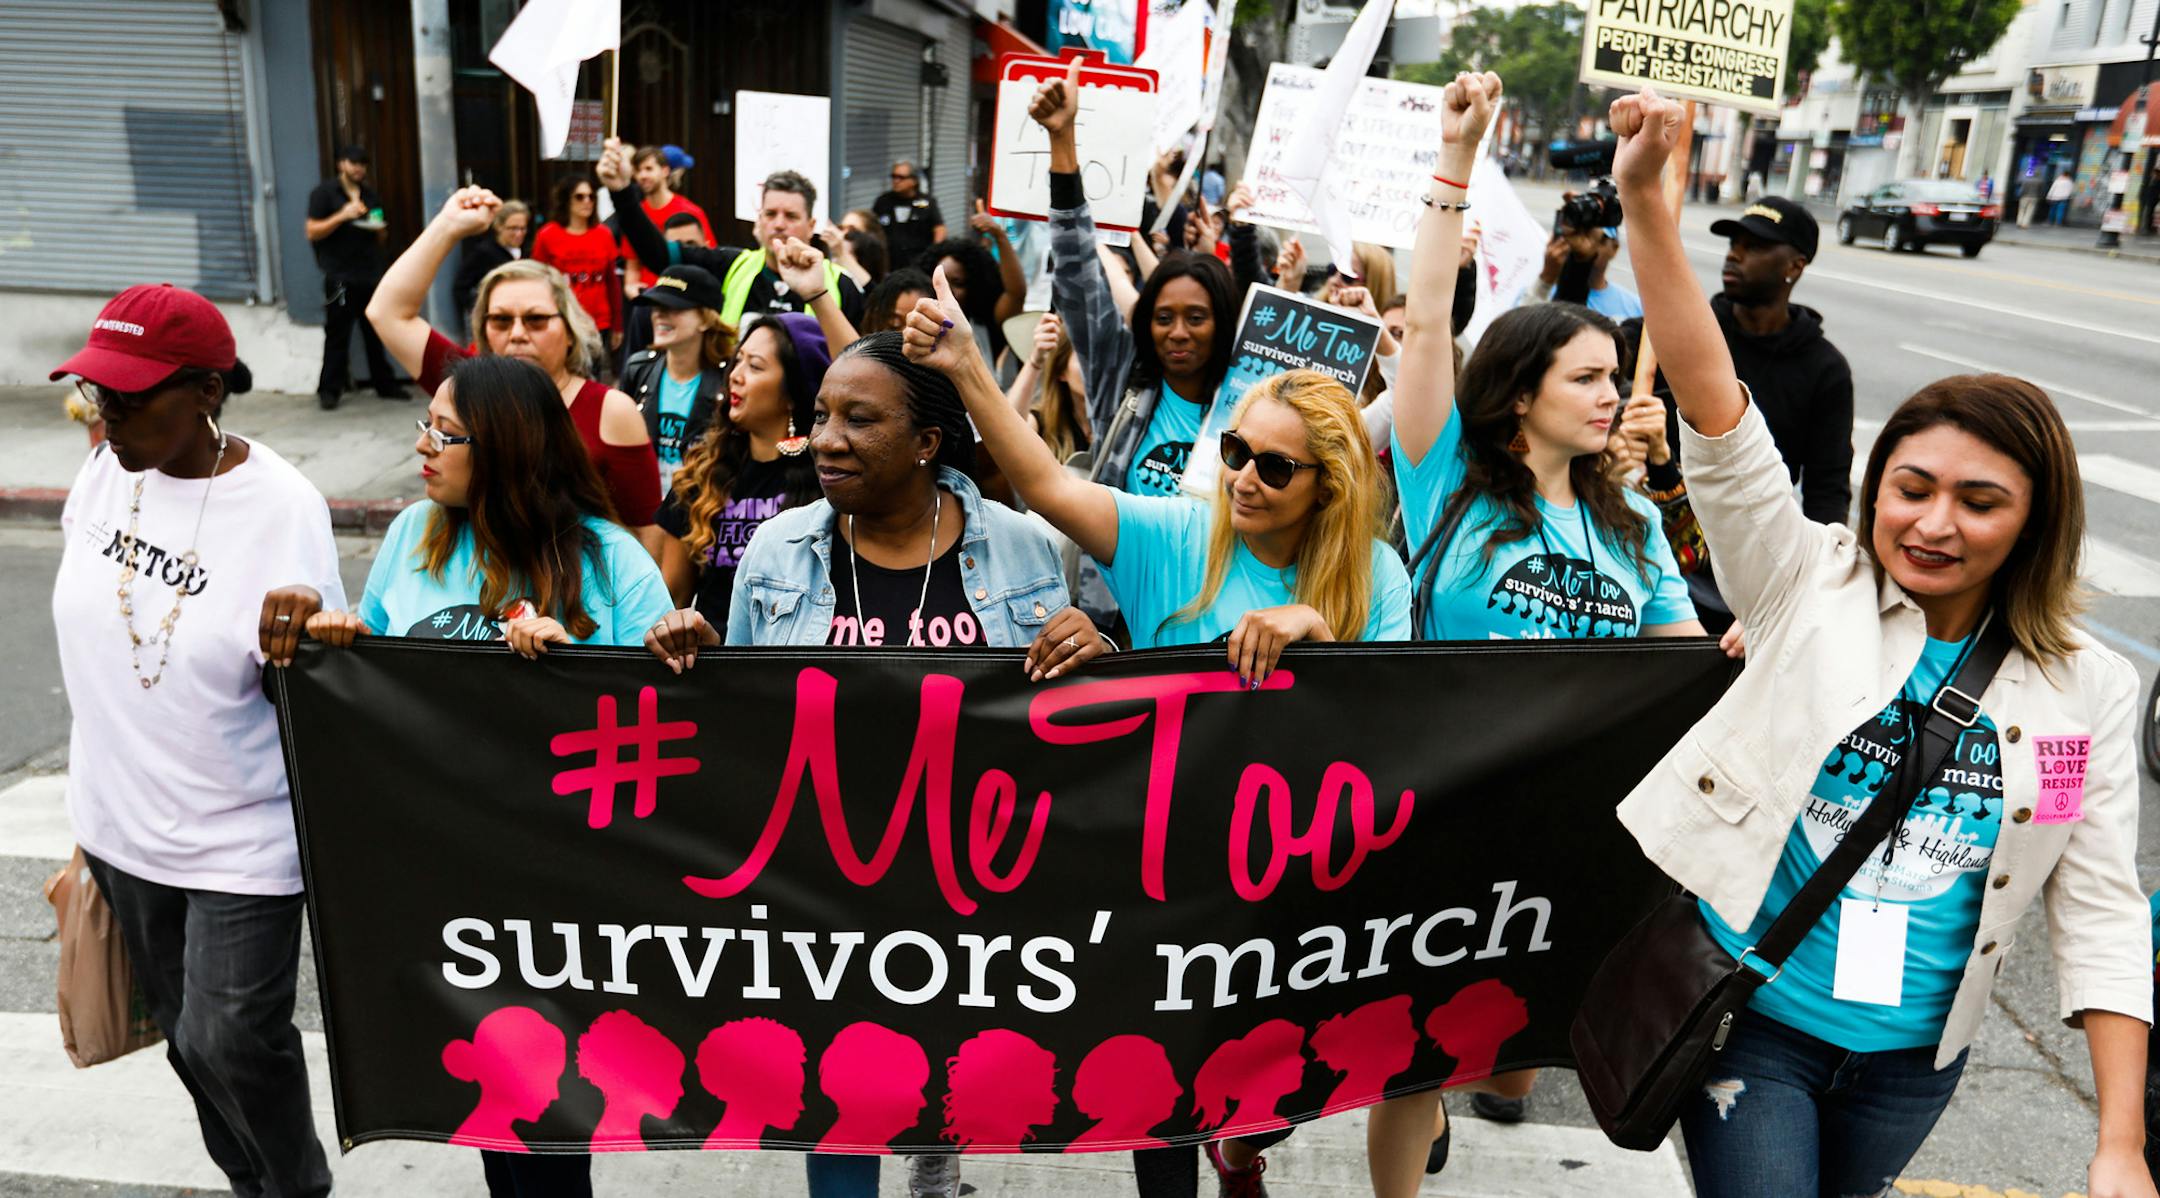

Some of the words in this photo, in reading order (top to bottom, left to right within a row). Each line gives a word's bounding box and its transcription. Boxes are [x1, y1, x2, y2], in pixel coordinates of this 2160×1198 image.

[1598, 26, 1687, 61] PEOPLE'S
[1690, 43, 1777, 79] CONGRESS
[1620, 54, 1648, 76] OF
[1649, 57, 1754, 96] RESISTANCE
[1009, 151, 1128, 201] TO!
[1242, 339, 1311, 368] survivors'
[1311, 361, 1357, 385] march
[831, 615, 885, 646] me
[1840, 733, 1901, 768] surviv
[2037, 740, 2089, 757] RISE
[2039, 759, 2087, 774] LOVE
[1941, 767, 2004, 792] marc
[2041, 777, 2084, 790] RESIST
[1806, 798, 1853, 843] Holly
[441, 904, 1112, 1013] survivors'
[1153, 880, 1553, 1011] march
